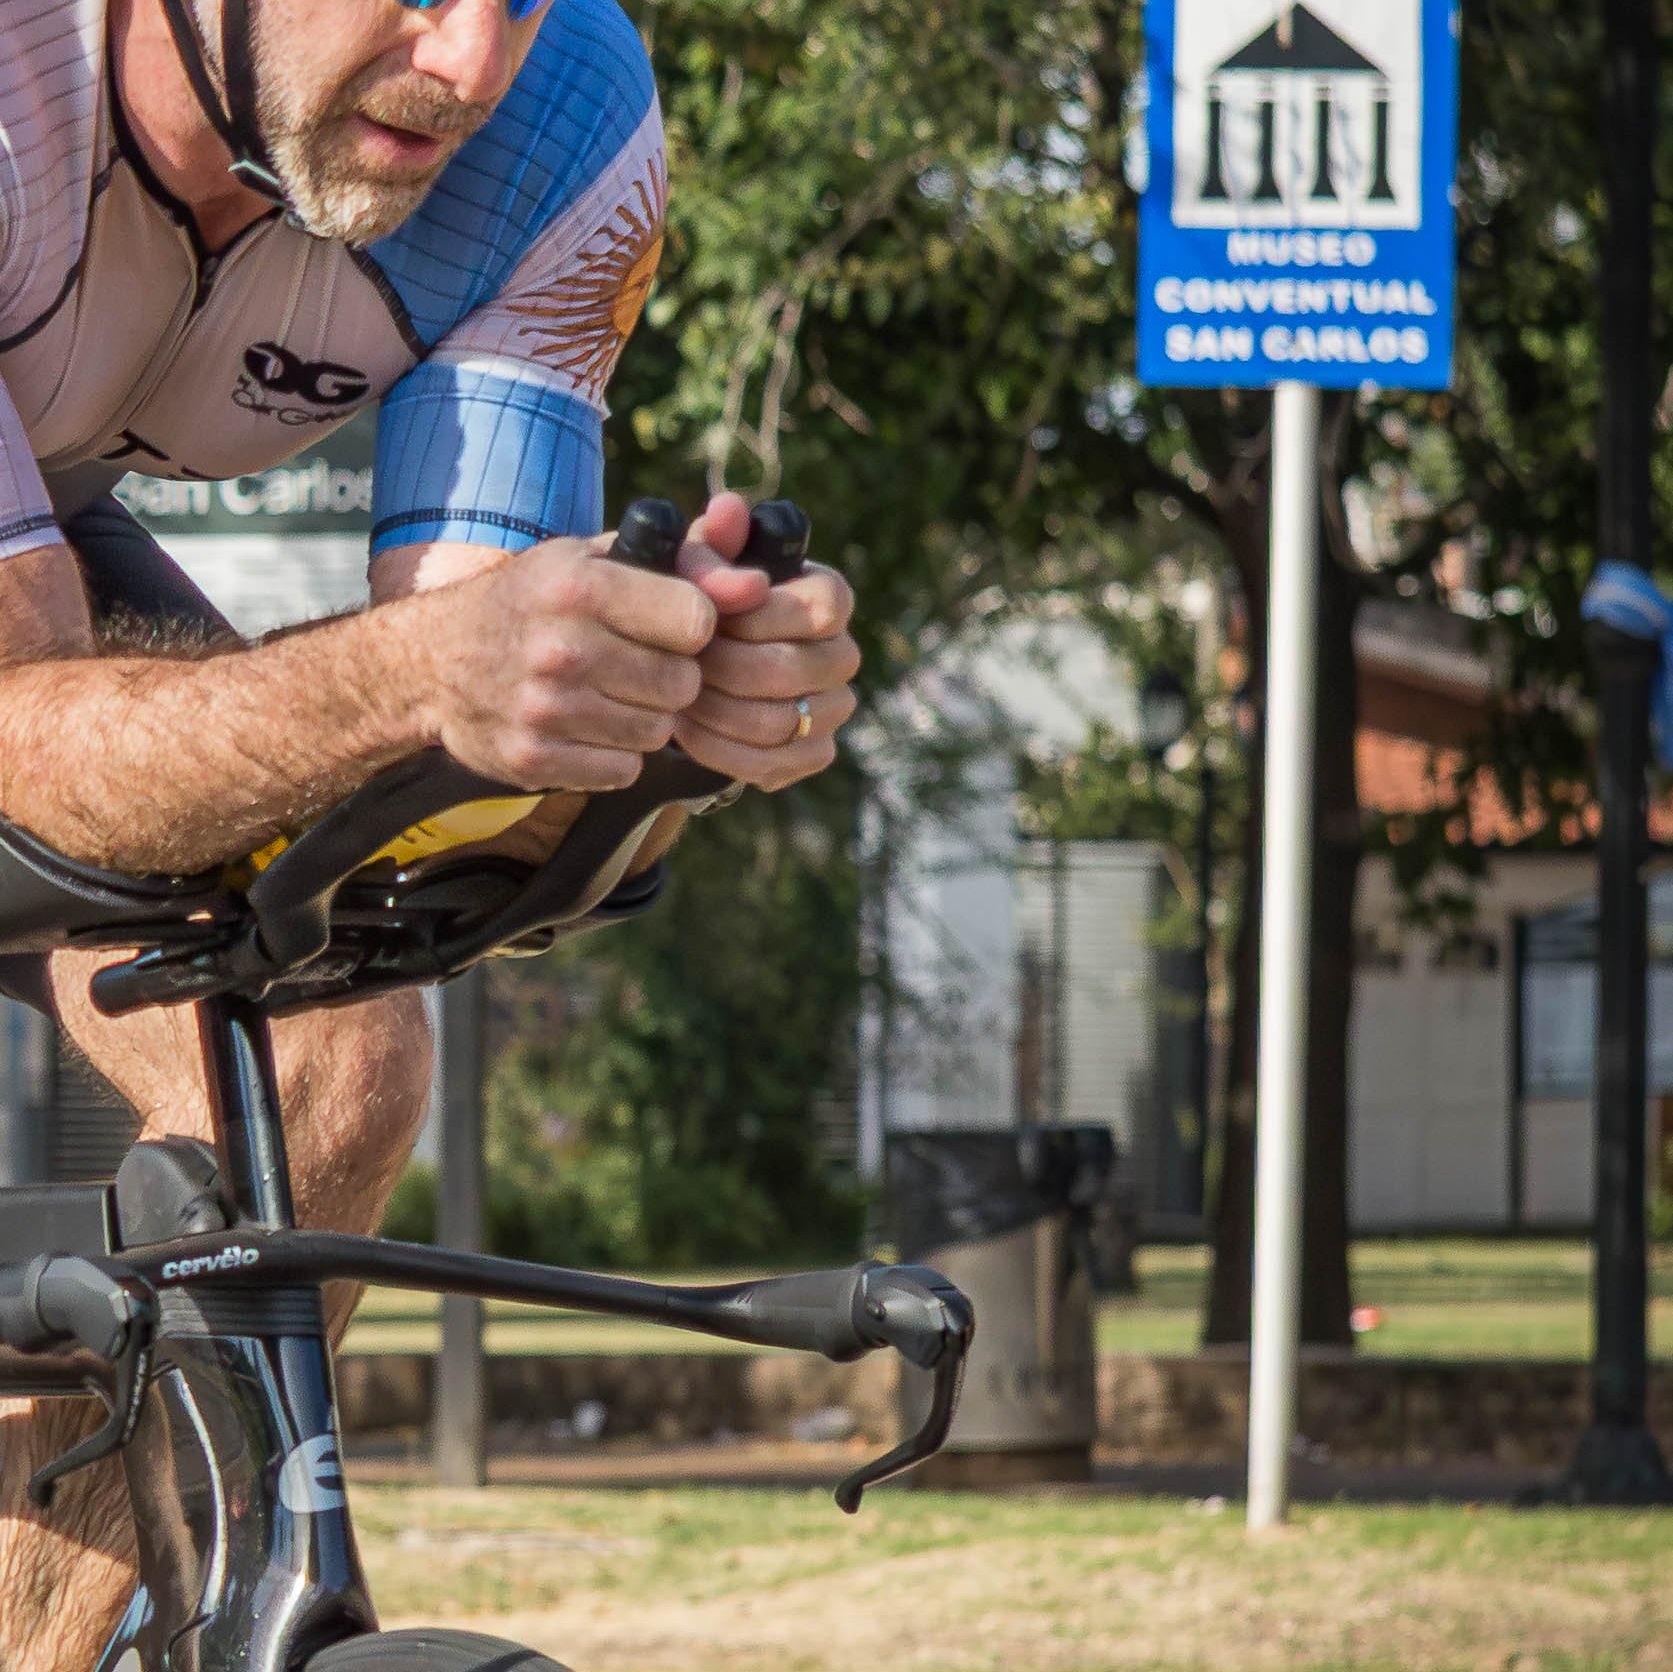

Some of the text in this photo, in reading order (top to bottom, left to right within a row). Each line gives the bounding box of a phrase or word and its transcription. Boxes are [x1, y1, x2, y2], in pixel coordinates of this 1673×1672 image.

[1227, 231, 1377, 267] MUSEO
[1154, 277, 1438, 316] CONVENTUAL
[1165, 324, 1429, 364] SAN CARLOS
